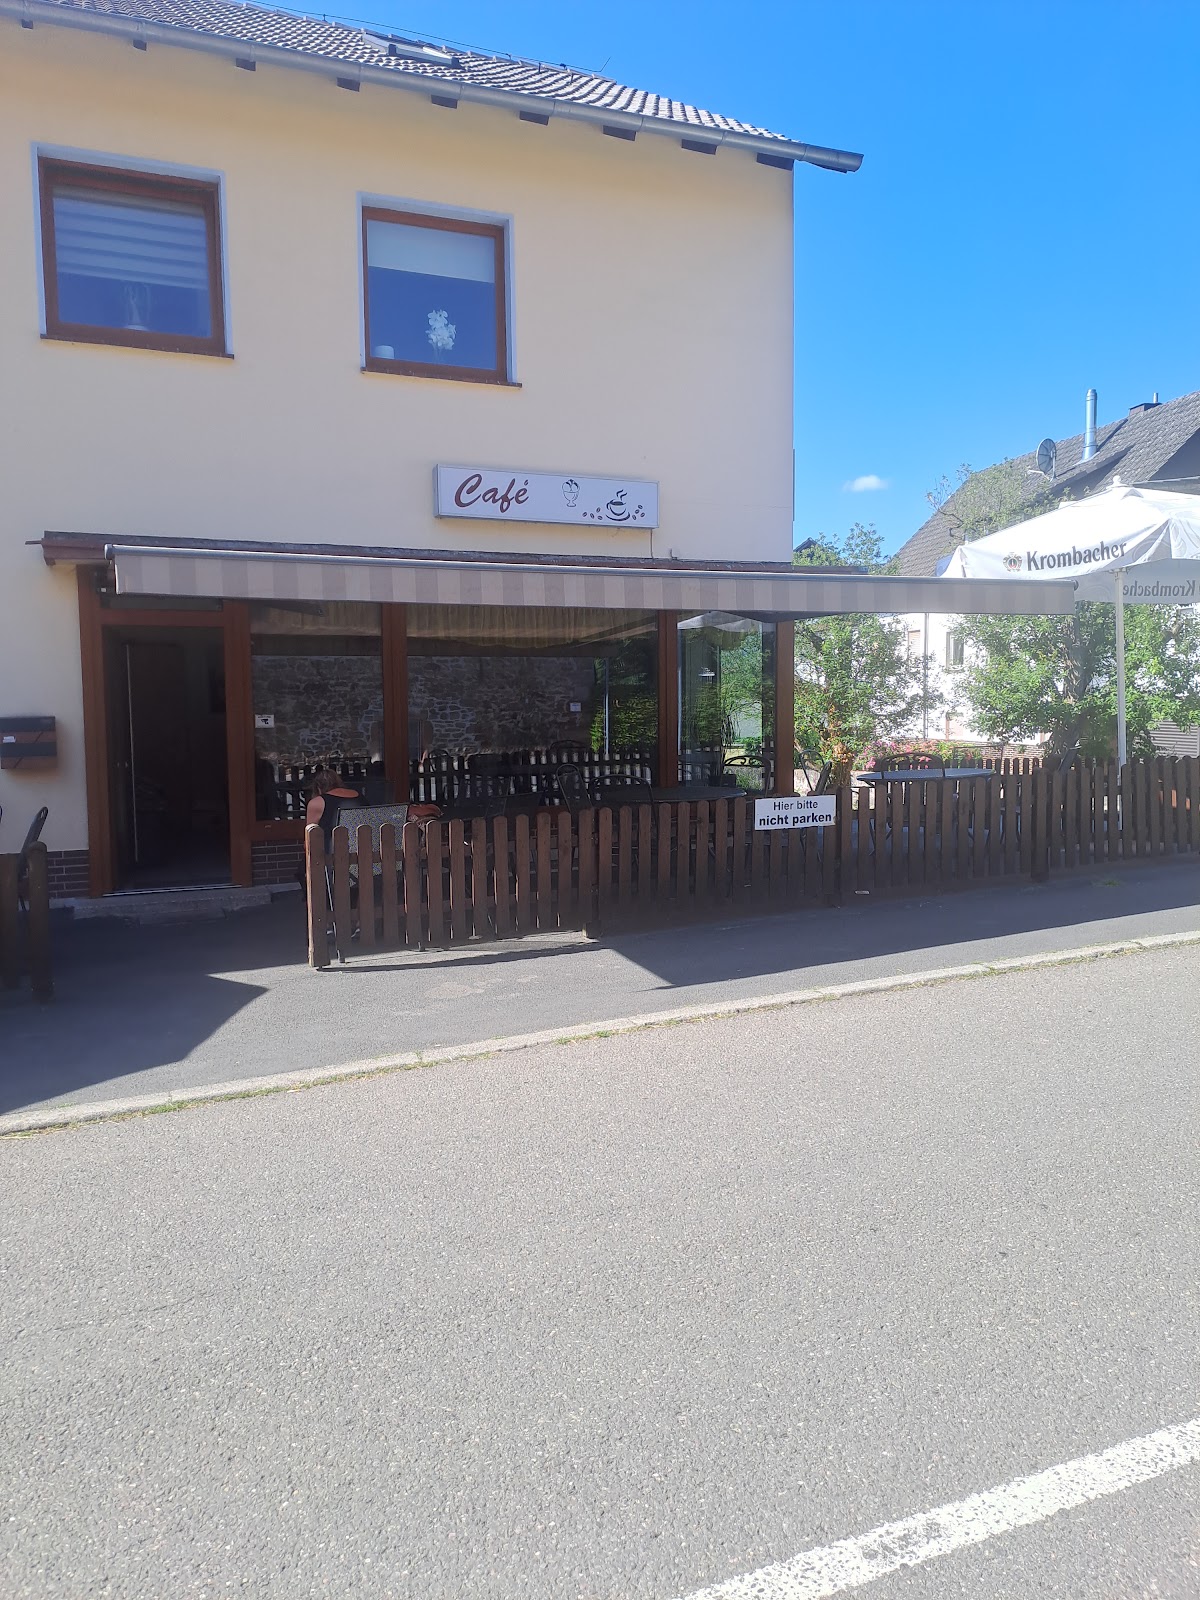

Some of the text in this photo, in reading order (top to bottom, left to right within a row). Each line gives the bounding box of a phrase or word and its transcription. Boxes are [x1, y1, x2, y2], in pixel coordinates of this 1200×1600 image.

[454, 473, 529, 513] Café
[1026, 541, 1127, 571] Krombacher
[773, 800, 819, 811] Hier bitte
[759, 812, 832, 826] nicht parken
